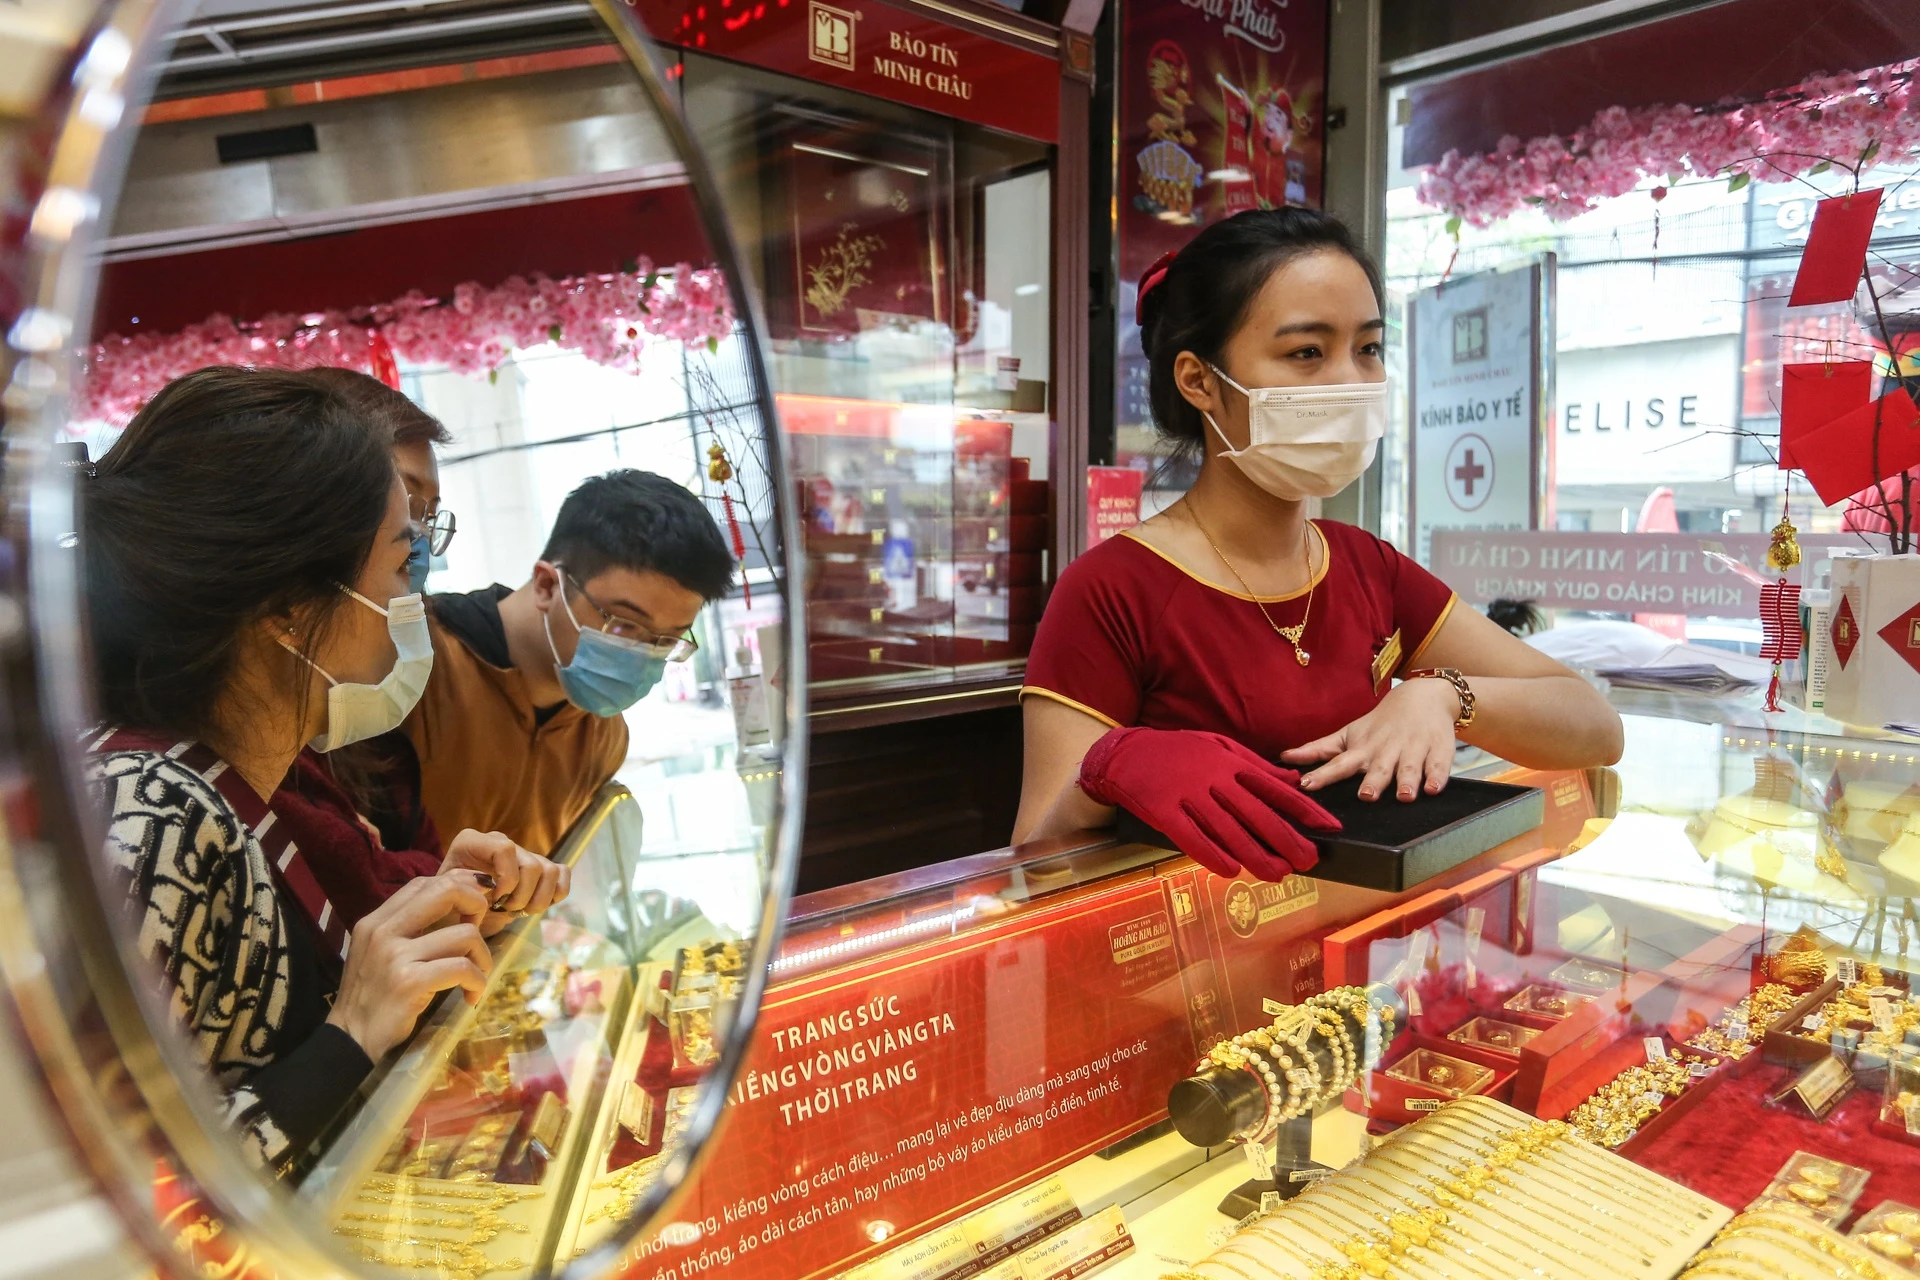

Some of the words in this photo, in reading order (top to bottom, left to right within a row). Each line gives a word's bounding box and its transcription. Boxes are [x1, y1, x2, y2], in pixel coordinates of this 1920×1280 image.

[889, 30, 927, 58] BẢO
[929, 42, 959, 67] TÍN
[873, 56, 921, 86] MINH
[925, 74, 972, 100] CHÂU
[1421, 403, 1451, 428] KÍNH
[1493, 400, 1501, 419] Y
[1507, 387, 1524, 417] TẾ
[1566, 395, 1697, 433] ELISE
[1262, 882, 1286, 905] KIM
[1262, 902, 1295, 919] COLLECTION
[1113, 931, 1138, 949] HOÀNG
[1138, 927, 1152, 941] KIM
[1120, 950, 1133, 959] PURE
[1133, 946, 1147, 955] GOLD
[1289, 957, 1299, 972] là
[772, 1010, 853, 1053] TRANG
[856, 995, 901, 1027] SỨC
[798, 1042, 866, 1081] VÒNG
[867, 1021, 929, 1058] VÀNG
[928, 1012, 956, 1037] TA
[779, 1087, 839, 1126] THỜI
[841, 1060, 918, 1104] TRANG
[634, 1233, 668, 1261] thời
[723, 1192, 769, 1225] kiềng
[770, 1177, 809, 1204] vòng
[811, 1161, 845, 1187] cách
[896, 1128, 935, 1154] mang
[936, 1118, 951, 1140] lại
[953, 1111, 968, 1130] vẻ
[970, 1103, 994, 1124] đẹp
[996, 1095, 1014, 1113] dịu
[1016, 1083, 1045, 1104] dàng
[1047, 1072, 1064, 1092] mà
[1065, 1063, 1090, 1084] sang
[1091, 1052, 1111, 1076] quý
[1112, 1046, 1130, 1064] cho
[1131, 1039, 1148, 1055] các
[679, 1246, 735, 1279] thống,
[738, 1231, 757, 1254] áo
[761, 1218, 785, 1243] dài
[788, 1206, 822, 1232] cách
[824, 1192, 853, 1217] tân,
[854, 1183, 879, 1205] hay
[882, 1166, 927, 1192] những
[927, 1152, 946, 1172] bộ
[947, 1144, 969, 1162] váy
[971, 1137, 986, 1154] áo
[988, 1123, 1013, 1145] kiểu
[1014, 1114, 1044, 1135] dáng
[1045, 1101, 1058, 1119] cổ
[1060, 1092, 1086, 1113] điển,
[1087, 1083, 1108, 1102] tinh
[1109, 1074, 1122, 1092] tế.
